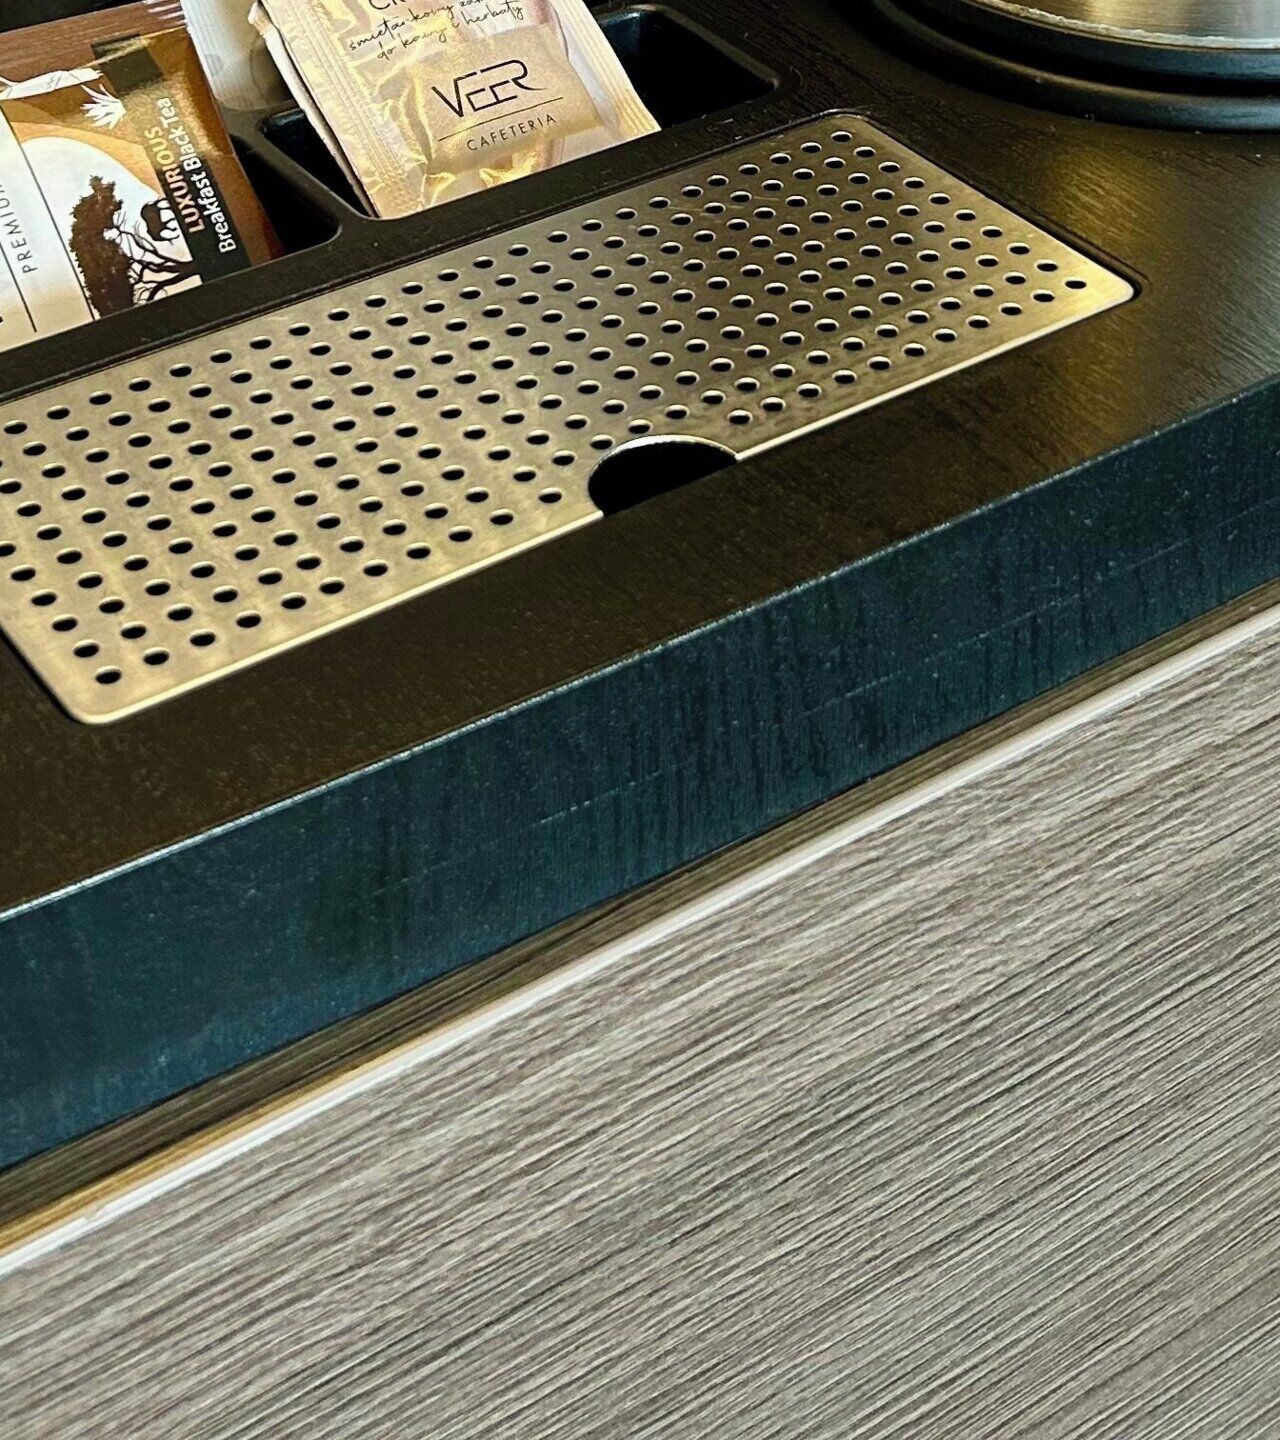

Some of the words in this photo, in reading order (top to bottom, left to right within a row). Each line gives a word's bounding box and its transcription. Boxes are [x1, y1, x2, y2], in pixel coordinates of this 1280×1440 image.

[157, 97, 180, 129] Tea
[431, 59, 547, 118] VEER
[169, 125, 203, 172] Black
[466, 113, 557, 151] CAFETERIA
[143, 126, 206, 234] LUXURIOUS
[190, 171, 237, 254] Breakfast
